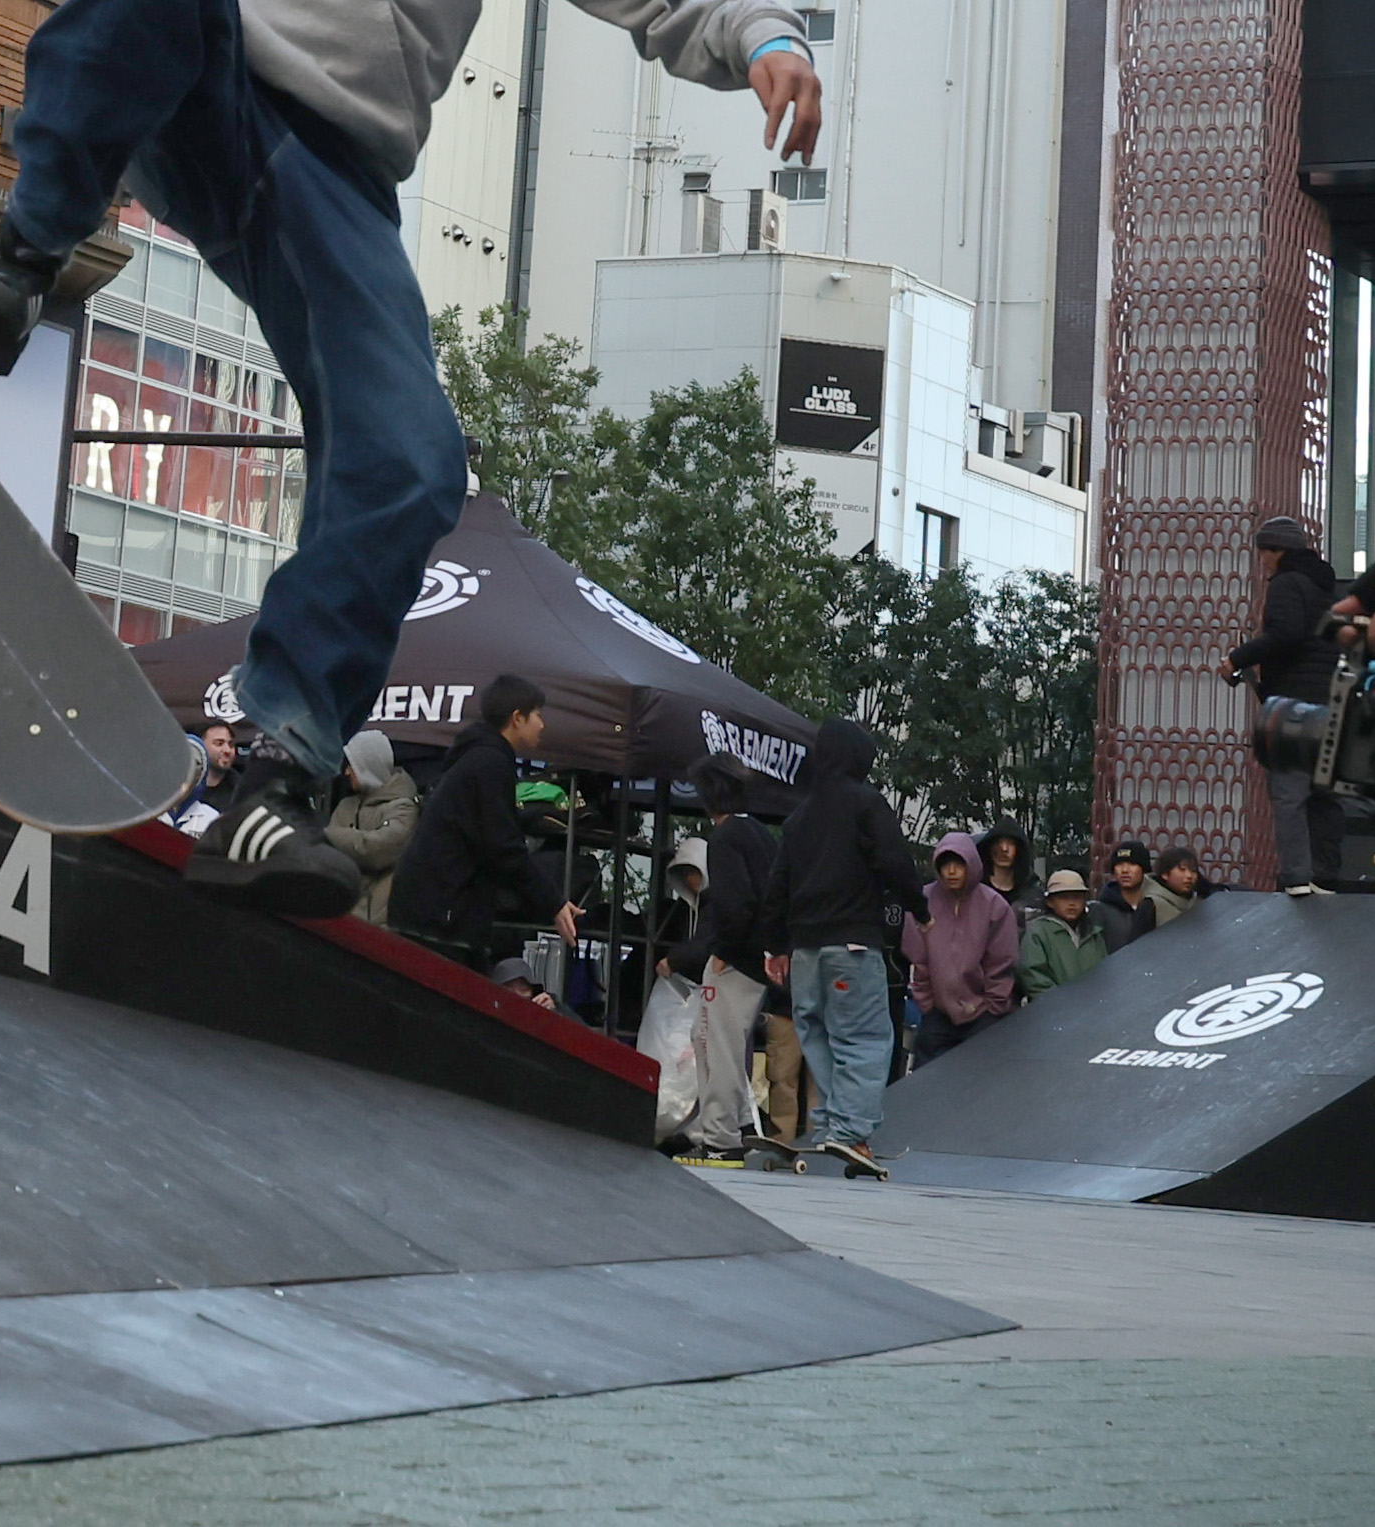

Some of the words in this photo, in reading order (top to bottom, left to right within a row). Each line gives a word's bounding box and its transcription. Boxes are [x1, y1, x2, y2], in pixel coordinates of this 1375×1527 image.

[811, 385, 851, 402] LUDI
[862, 440, 877, 452] 4F
[841, 503, 870, 514] CIRCUS
[856, 552, 870, 562] 3F
[724, 720, 808, 786] ELEMENT
[1087, 1047, 1228, 1070] ELEMENT
